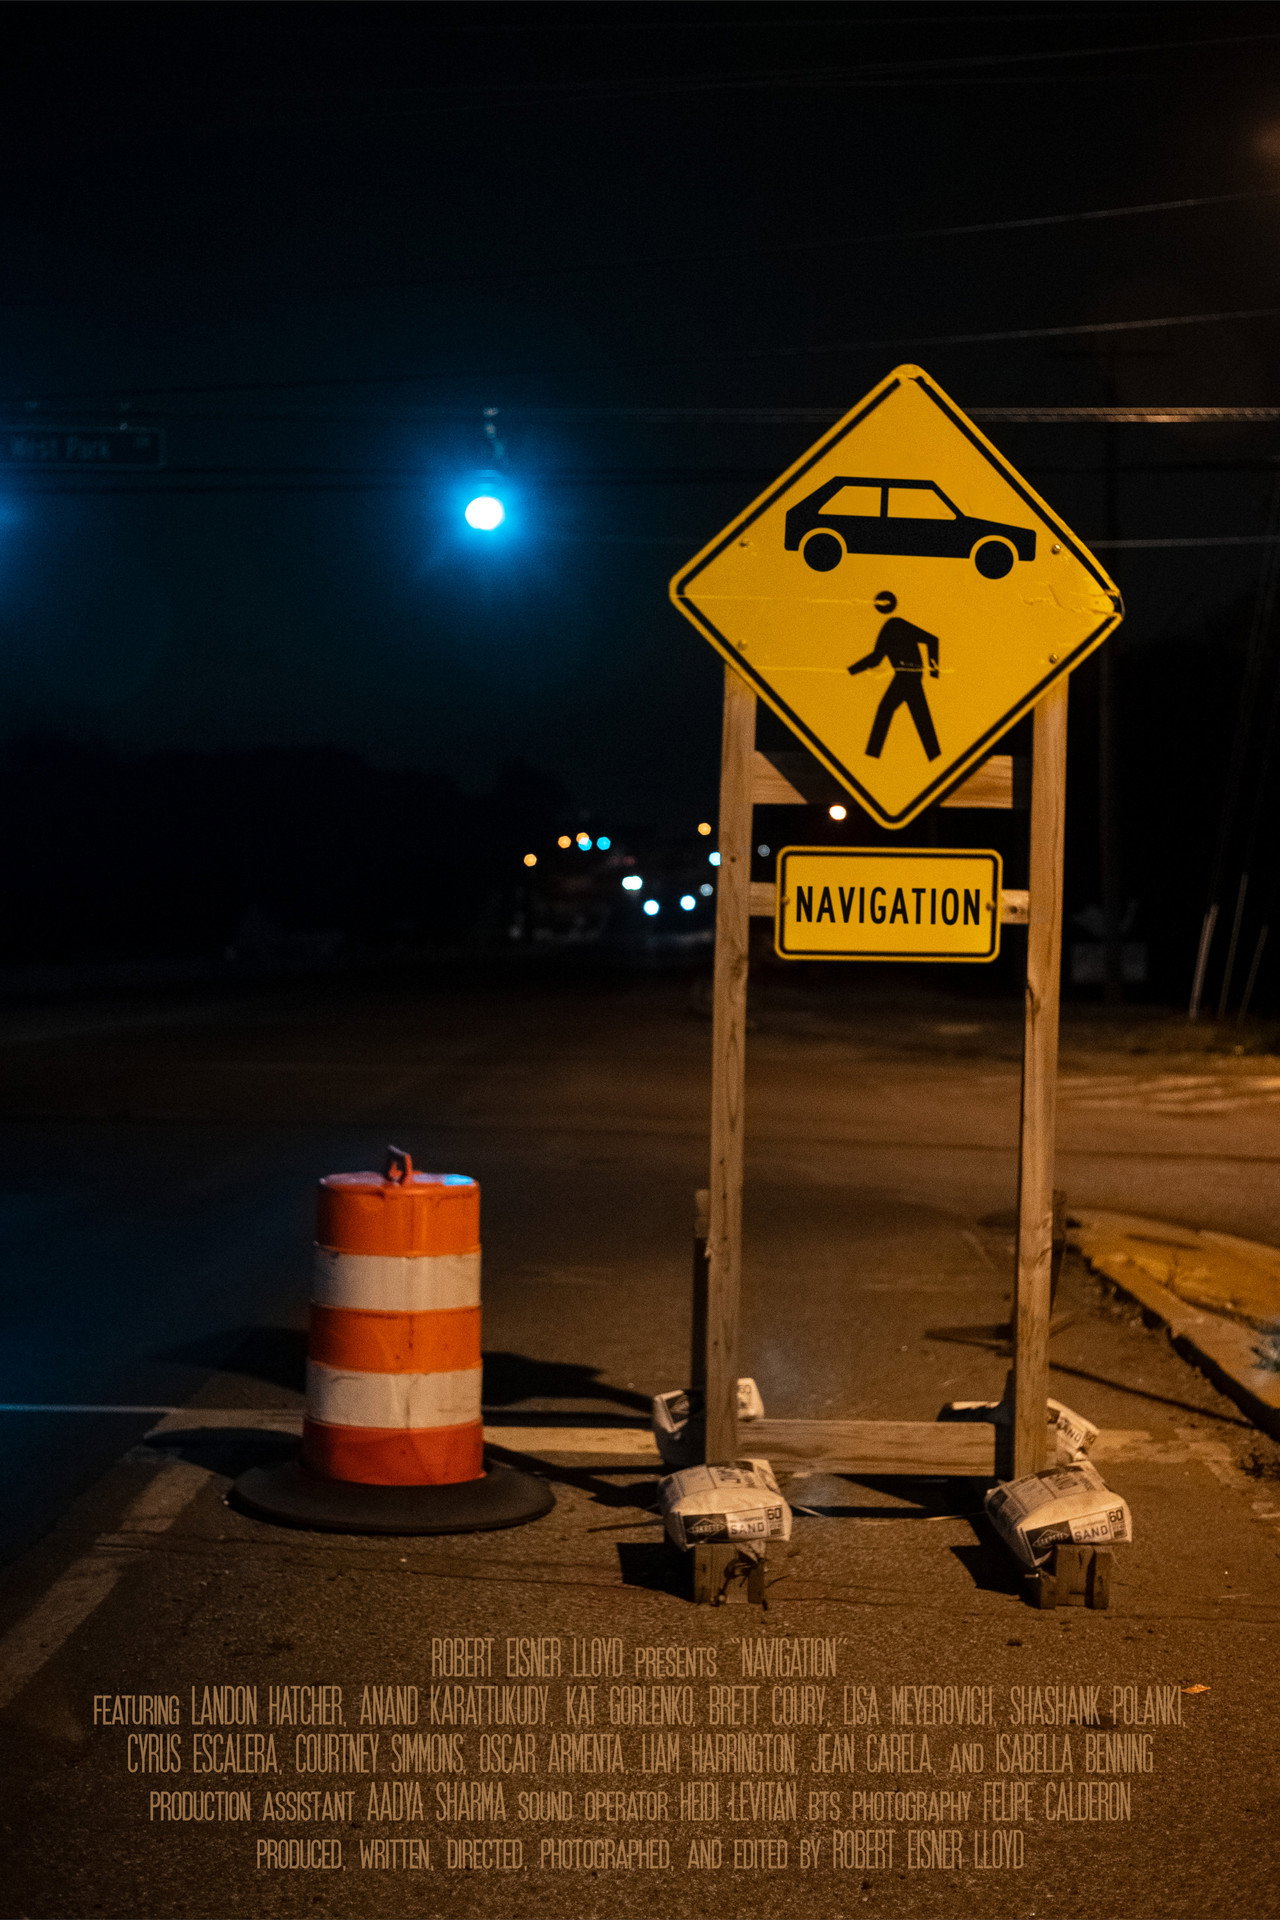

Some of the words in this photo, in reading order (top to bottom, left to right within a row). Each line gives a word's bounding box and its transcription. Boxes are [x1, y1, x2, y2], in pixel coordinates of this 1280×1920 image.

[795, 885, 981, 926] NAVIGATION
[766, 1507, 782, 1521] 60
[1108, 1508, 1123, 1522] 60
[730, 1521, 765, 1535] SAND
[1074, 1525, 1109, 1541] SAND
